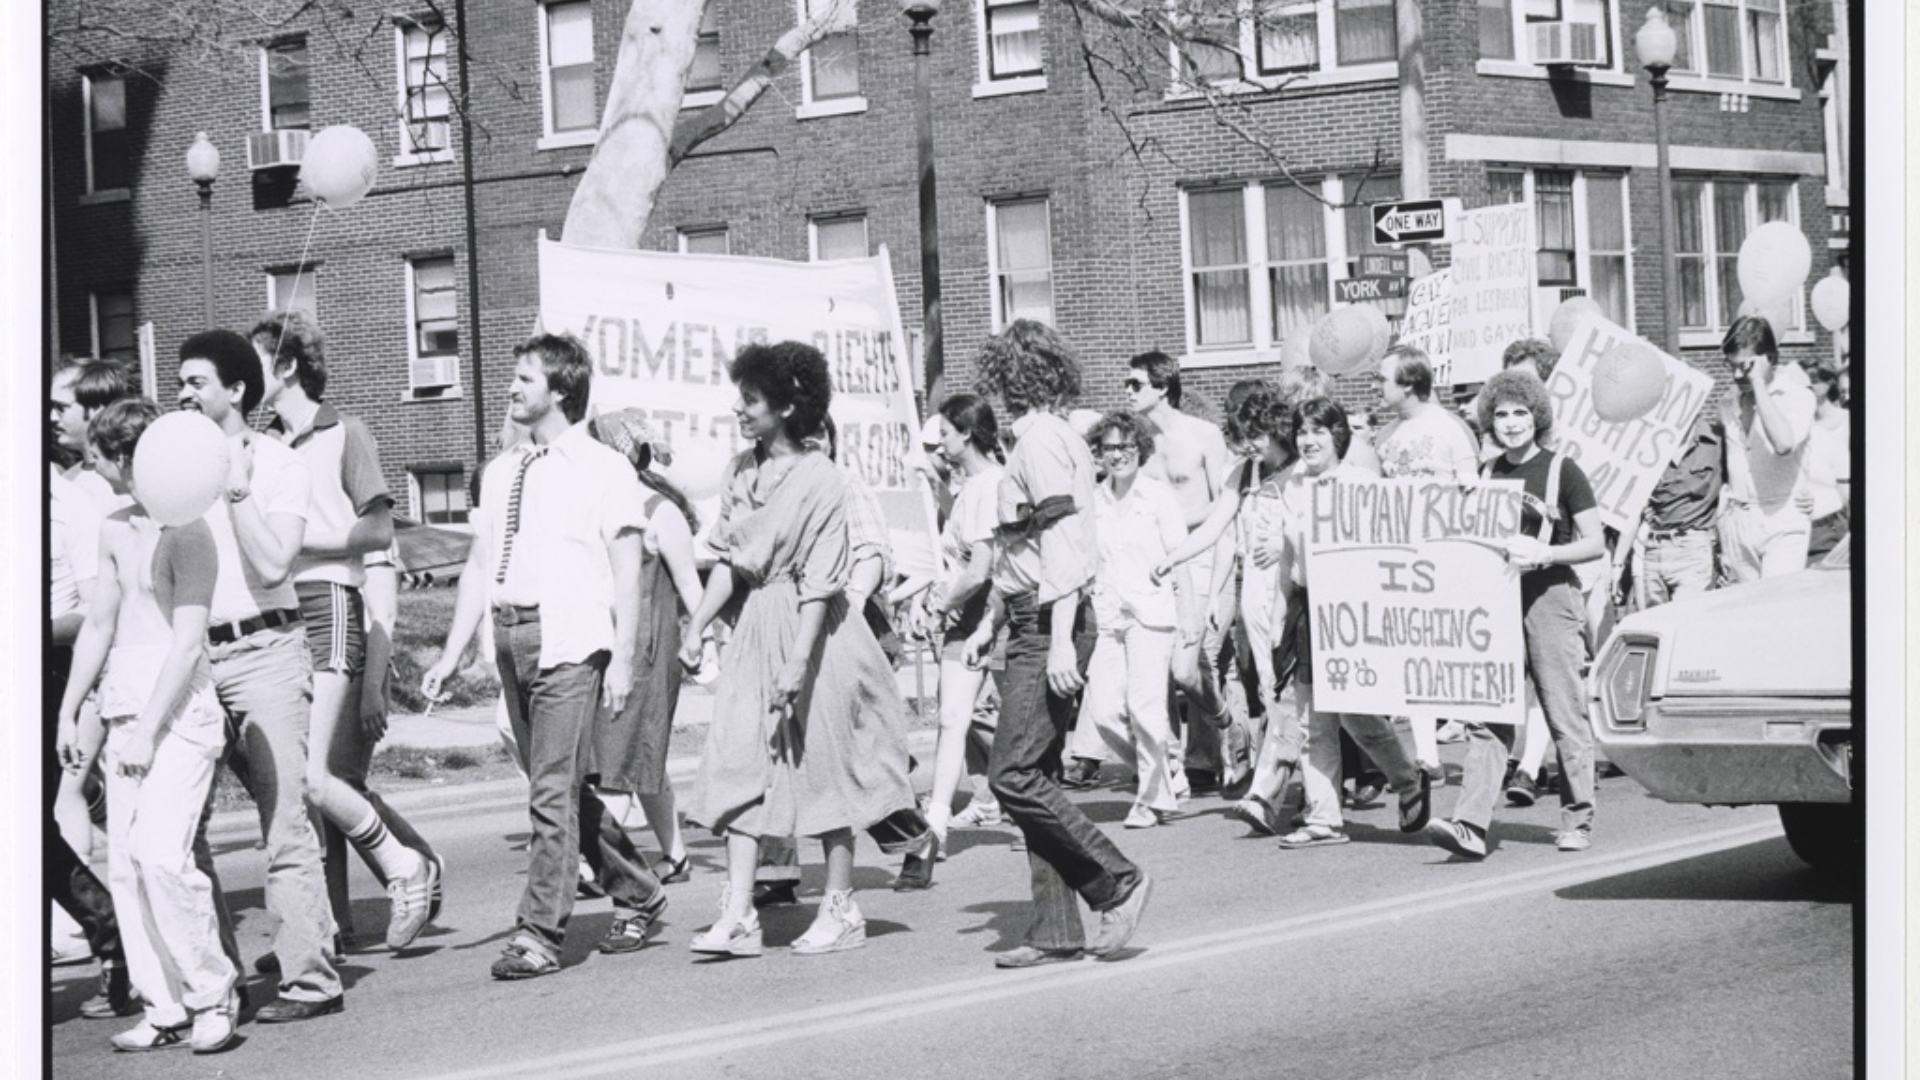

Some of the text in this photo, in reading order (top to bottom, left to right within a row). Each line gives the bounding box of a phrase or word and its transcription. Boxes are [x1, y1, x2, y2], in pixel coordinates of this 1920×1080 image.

[1386, 212, 1440, 231] ONE WAY
[1455, 208, 1529, 247] I SUPPORT
[1488, 247, 1527, 280] RIGHTS
[1341, 280, 1382, 300] YORK
[1312, 482, 1523, 544] HUMAN RIGHTS
[1378, 559, 1436, 594] IS
[1362, 601, 1492, 652] LAUGHING
[1404, 656, 1516, 704] MATTER!!
